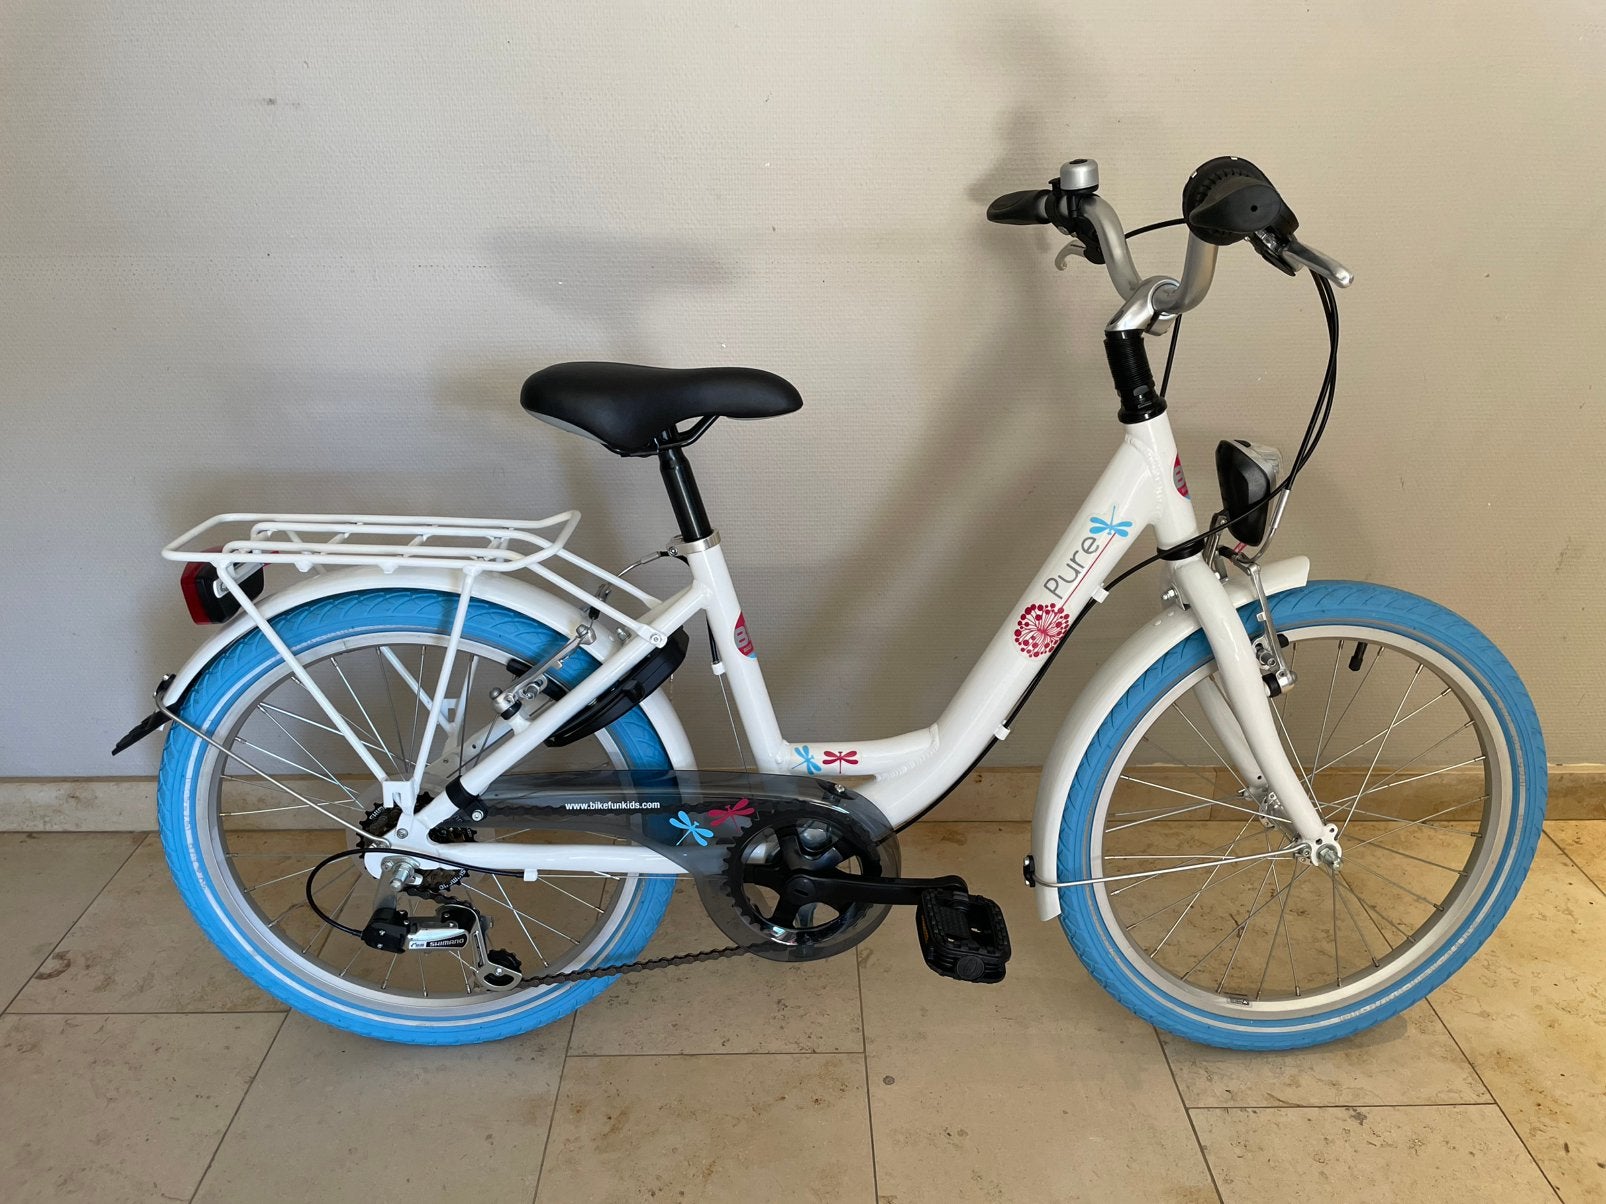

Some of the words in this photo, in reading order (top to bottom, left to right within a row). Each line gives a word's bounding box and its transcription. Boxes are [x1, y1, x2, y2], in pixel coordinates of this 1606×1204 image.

[1043, 536, 1100, 600] Pure
[565, 800, 660, 811] www.bikefunkids.com
[429, 938, 464, 947] SHIMANO
